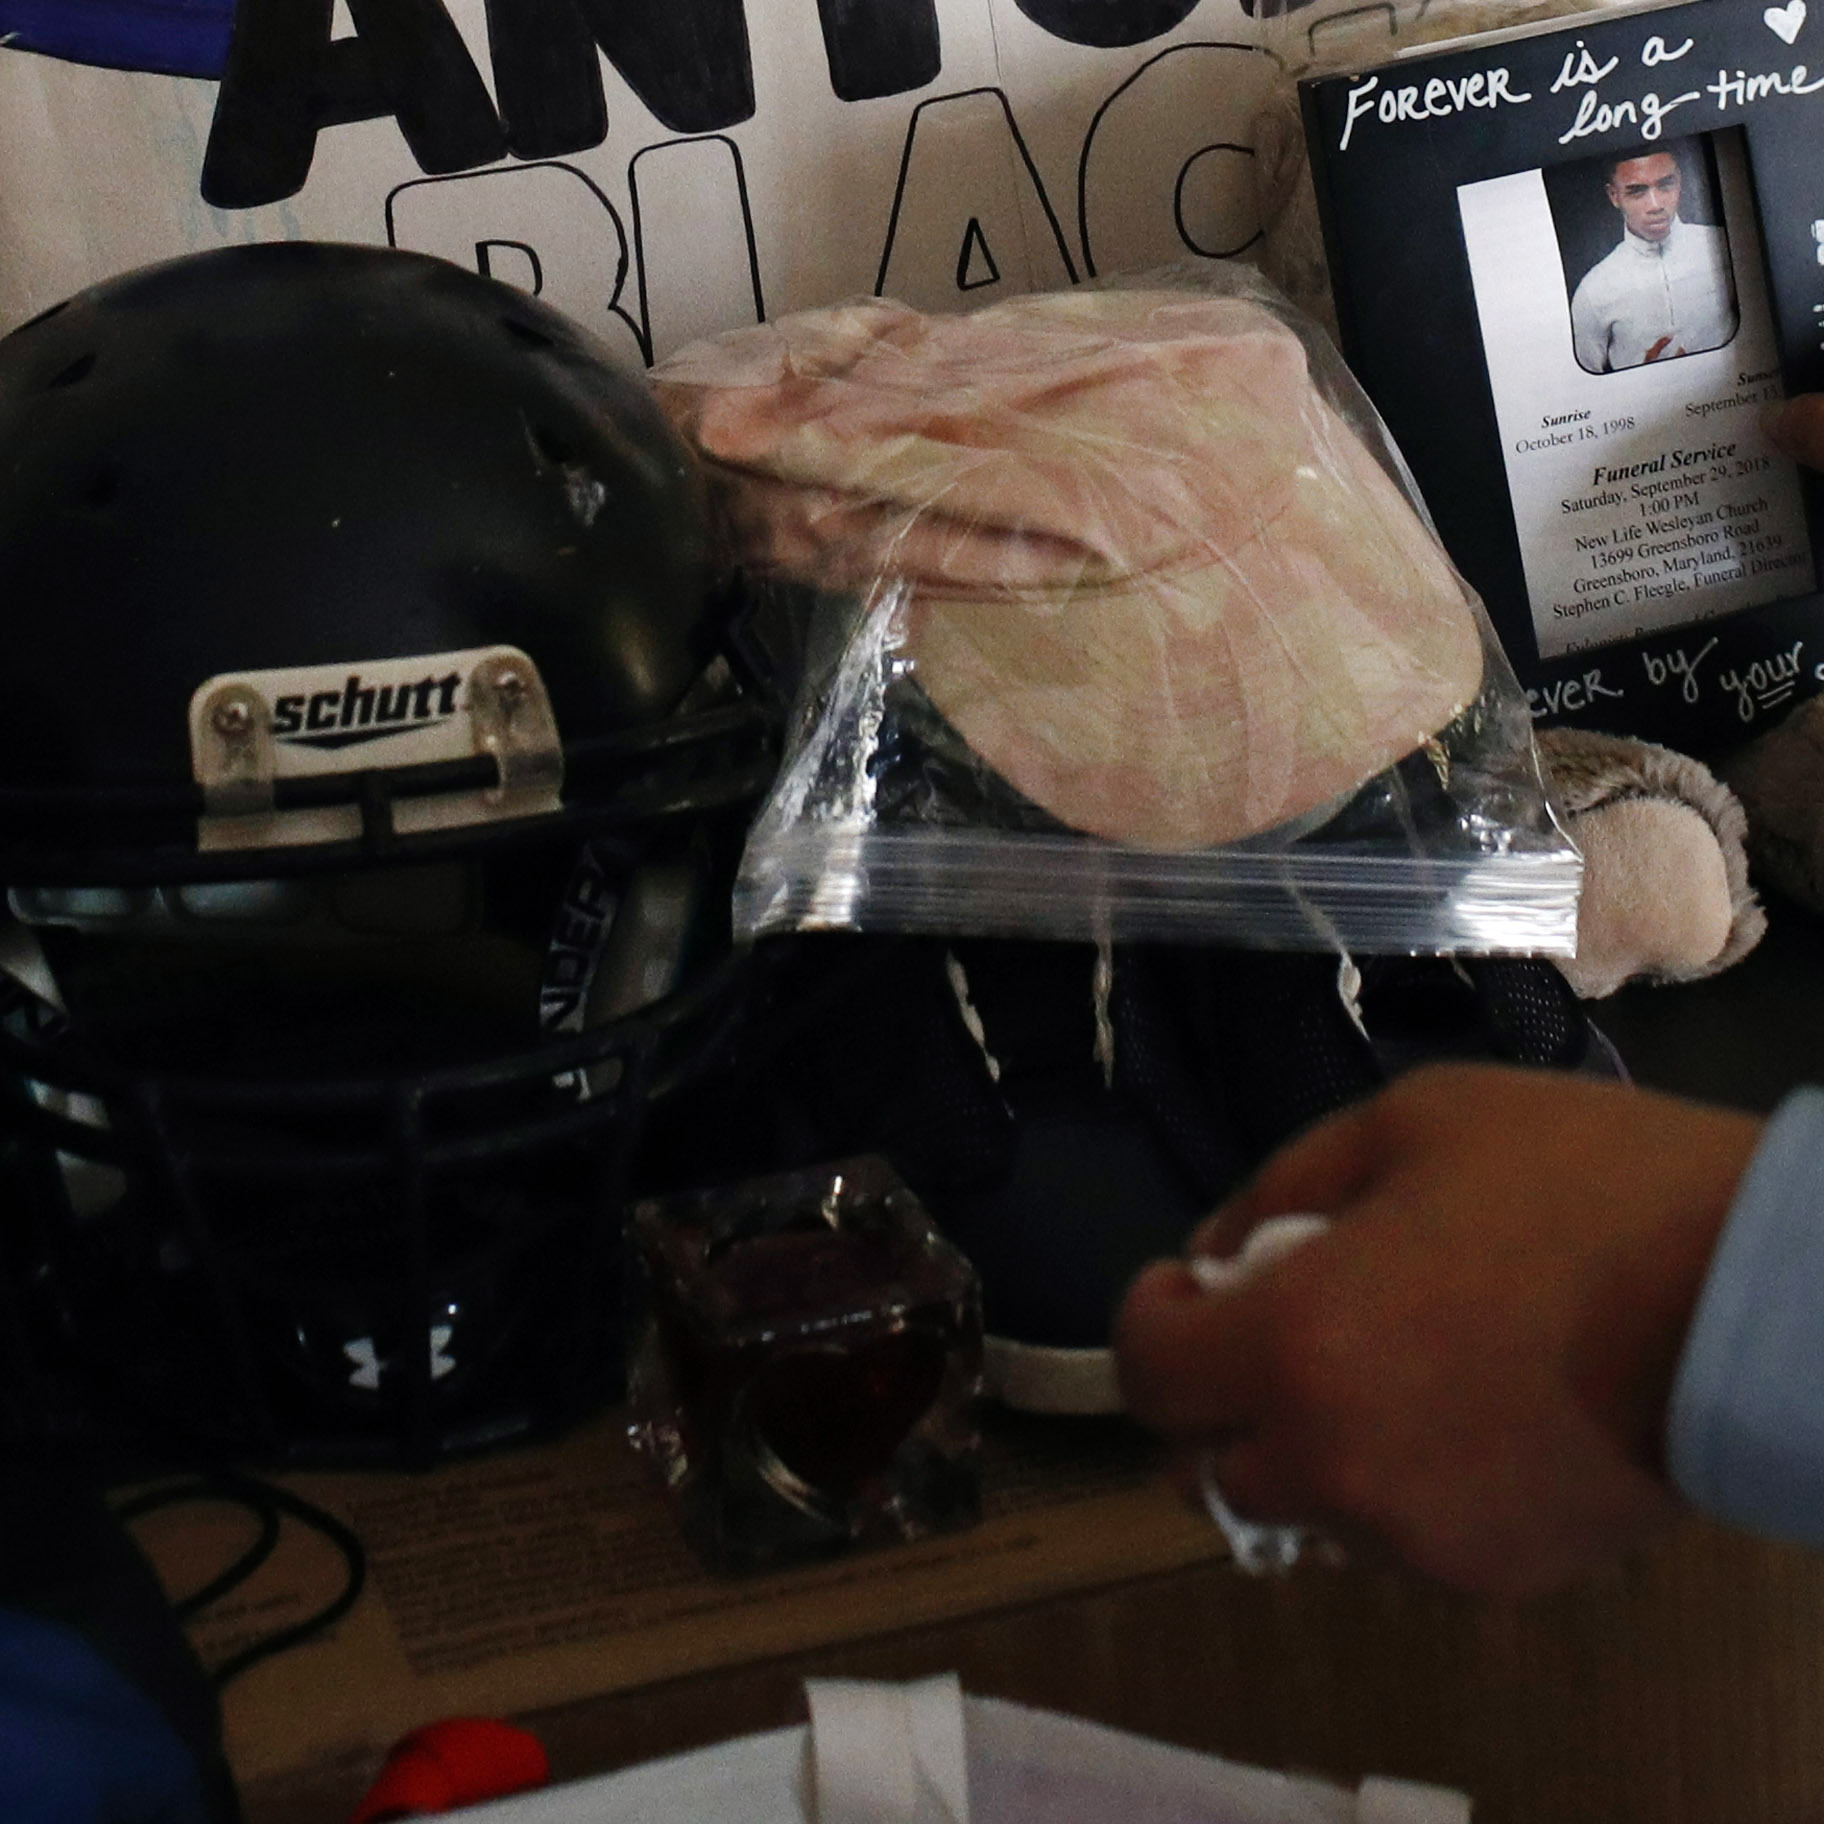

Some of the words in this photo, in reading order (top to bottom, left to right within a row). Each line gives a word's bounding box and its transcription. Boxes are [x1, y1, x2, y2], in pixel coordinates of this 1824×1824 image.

[1550, 40, 1619, 93] is
[1641, 35, 1694, 68] a
[1558, 90, 1701, 145] long
[1540, 407, 1592, 430] Sunrise
[1685, 391, 1758, 418] September
[1515, 433, 1574, 456] October
[1603, 416, 1637, 438] 1998
[1560, 487, 1629, 515] Saturday,
[1631, 471, 1707, 501] September
[1736, 456, 1772, 478] 2018
[1592, 453, 1666, 487] Funeral
[1670, 442, 1738, 468] Service
[1574, 530, 1610, 553] New
[1613, 521, 1644, 544] Life
[1646, 511, 1714, 538] Wesleyan
[1716, 496, 1770, 522] Church
[1639, 498, 1671, 519] 1:00
[1673, 491, 1701, 512] PM
[1572, 565, 1660, 595] Greensboro,
[1663, 546, 1736, 575] Maryland,
[1739, 533, 1783, 558] 21639
[1590, 546, 1634, 570] 13699
[1638, 530, 1720, 560] Greensboro
[1723, 518, 1761, 540] Road
[1552, 594, 1611, 621] Stephen
[1613, 589, 1632, 607] C.
[1694, 562, 1748, 588] Funeral
[1750, 550, 1808, 576] Director
[270, 670, 462, 737] schutt
[1643, 636, 1720, 704] by
[1719, 641, 1803, 723] your
